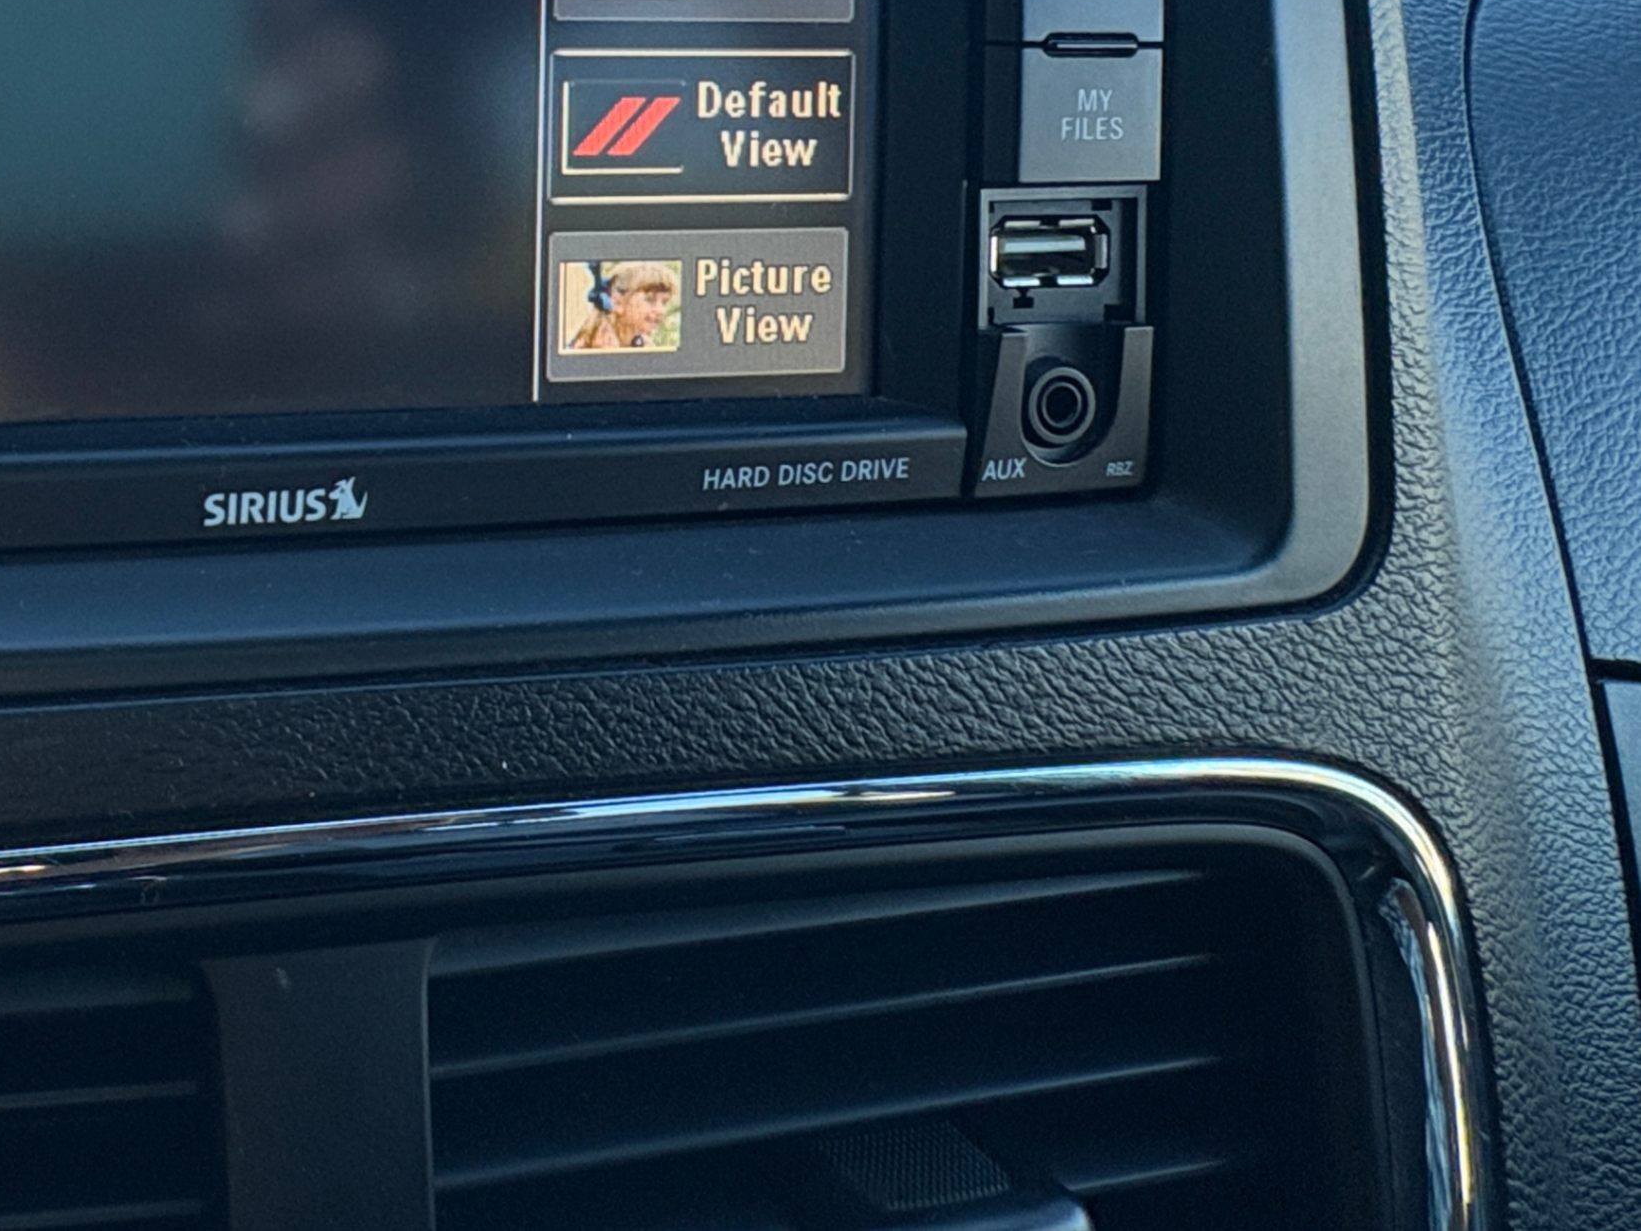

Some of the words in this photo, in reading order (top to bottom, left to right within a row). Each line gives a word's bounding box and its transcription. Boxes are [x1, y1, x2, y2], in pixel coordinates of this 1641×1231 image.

[696, 81, 842, 120] Default
[1078, 89, 1113, 112] MY
[1061, 117, 1124, 141] FILES
[720, 130, 818, 168] View
[695, 257, 832, 298] Picture
[715, 306, 813, 344] View
[702, 466, 771, 491] HARD
[777, 463, 837, 486] DISC
[840, 457, 910, 482] DRIVE
[982, 458, 1027, 481] AUX
[203, 488, 328, 527] SIRIUS
